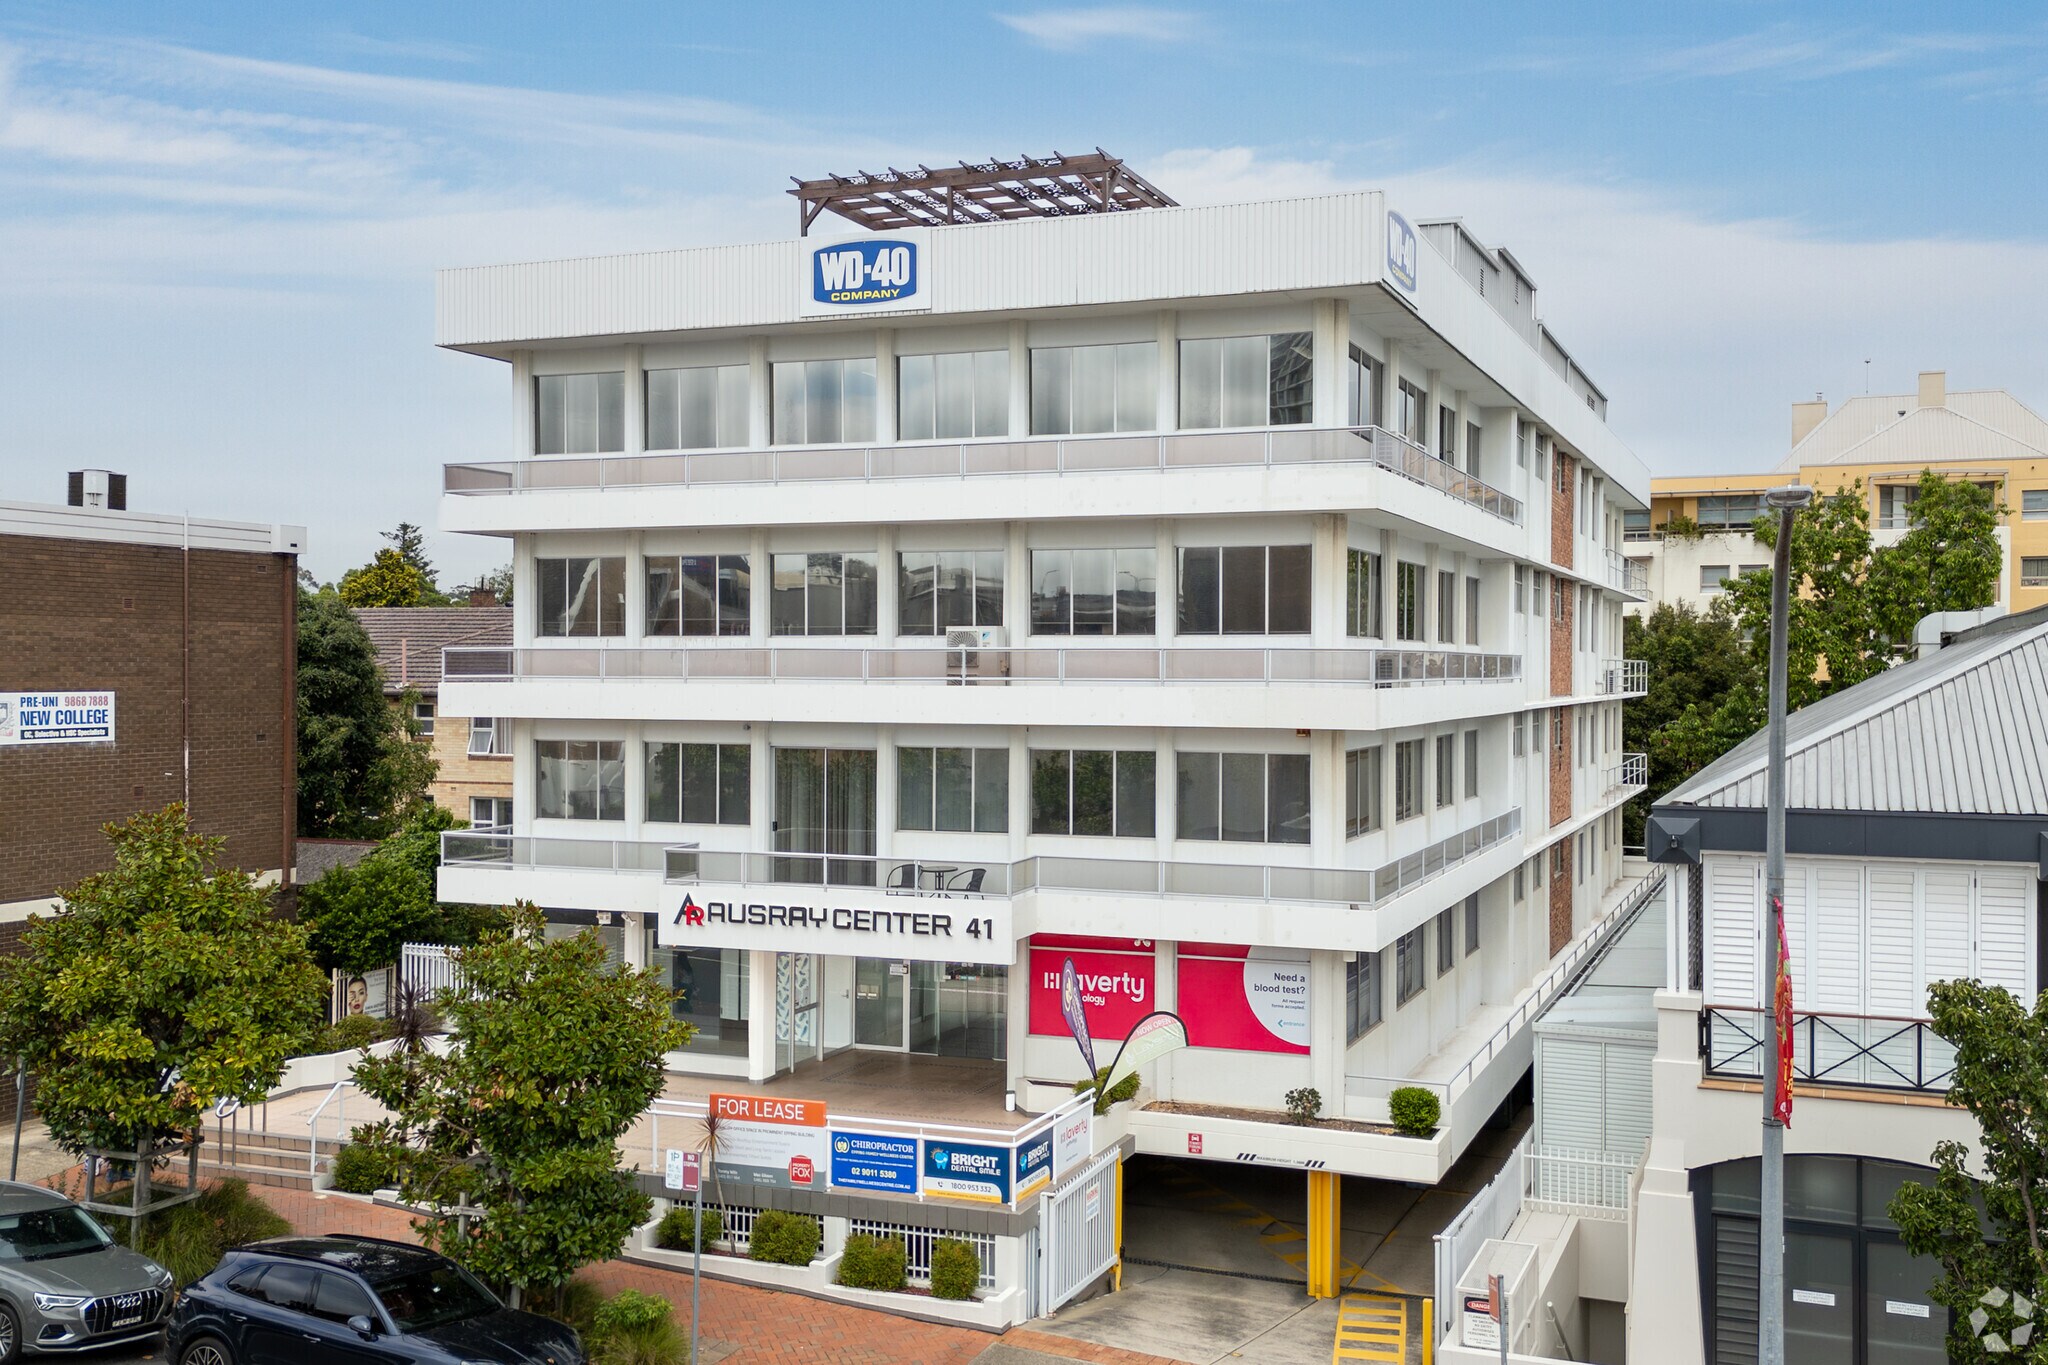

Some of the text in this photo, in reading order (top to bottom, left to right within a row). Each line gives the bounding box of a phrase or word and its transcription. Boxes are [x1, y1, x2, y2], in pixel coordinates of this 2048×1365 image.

[820, 247, 910, 290] WD-40
[831, 289, 900, 301] COMPANY
[20, 696, 109, 707] PRE-UNI 9868 7888
[20, 709, 109, 726] NEW COLLEGE
[707, 902, 994, 940] AUSRAY CENTER 41
[1274, 973, 1306, 983] Need a
[1254, 984, 1306, 995] blood test?
[1136, 1017, 1172, 1037] NOW OPEN
[718, 1098, 805, 1120] FOR LEASE
[1066, 1118, 1088, 1140] laverty
[851, 1140, 914, 1153] CHIROPRACTOR
[1028, 1141, 1049, 1162] BRIGHT
[951, 1153, 998, 1168] BRIGHT
[792, 1167, 811, 1178] FOX
[851, 1167, 861, 1175] 02
[861, 1168, 878, 1177] 9011
[951, 1165, 1001, 1176] DENTAL SMILE
[951, 1182, 966, 1190] 1800
[967, 1184, 979, 1192] 953
[1471, 1302, 1490, 1310] DANGE
